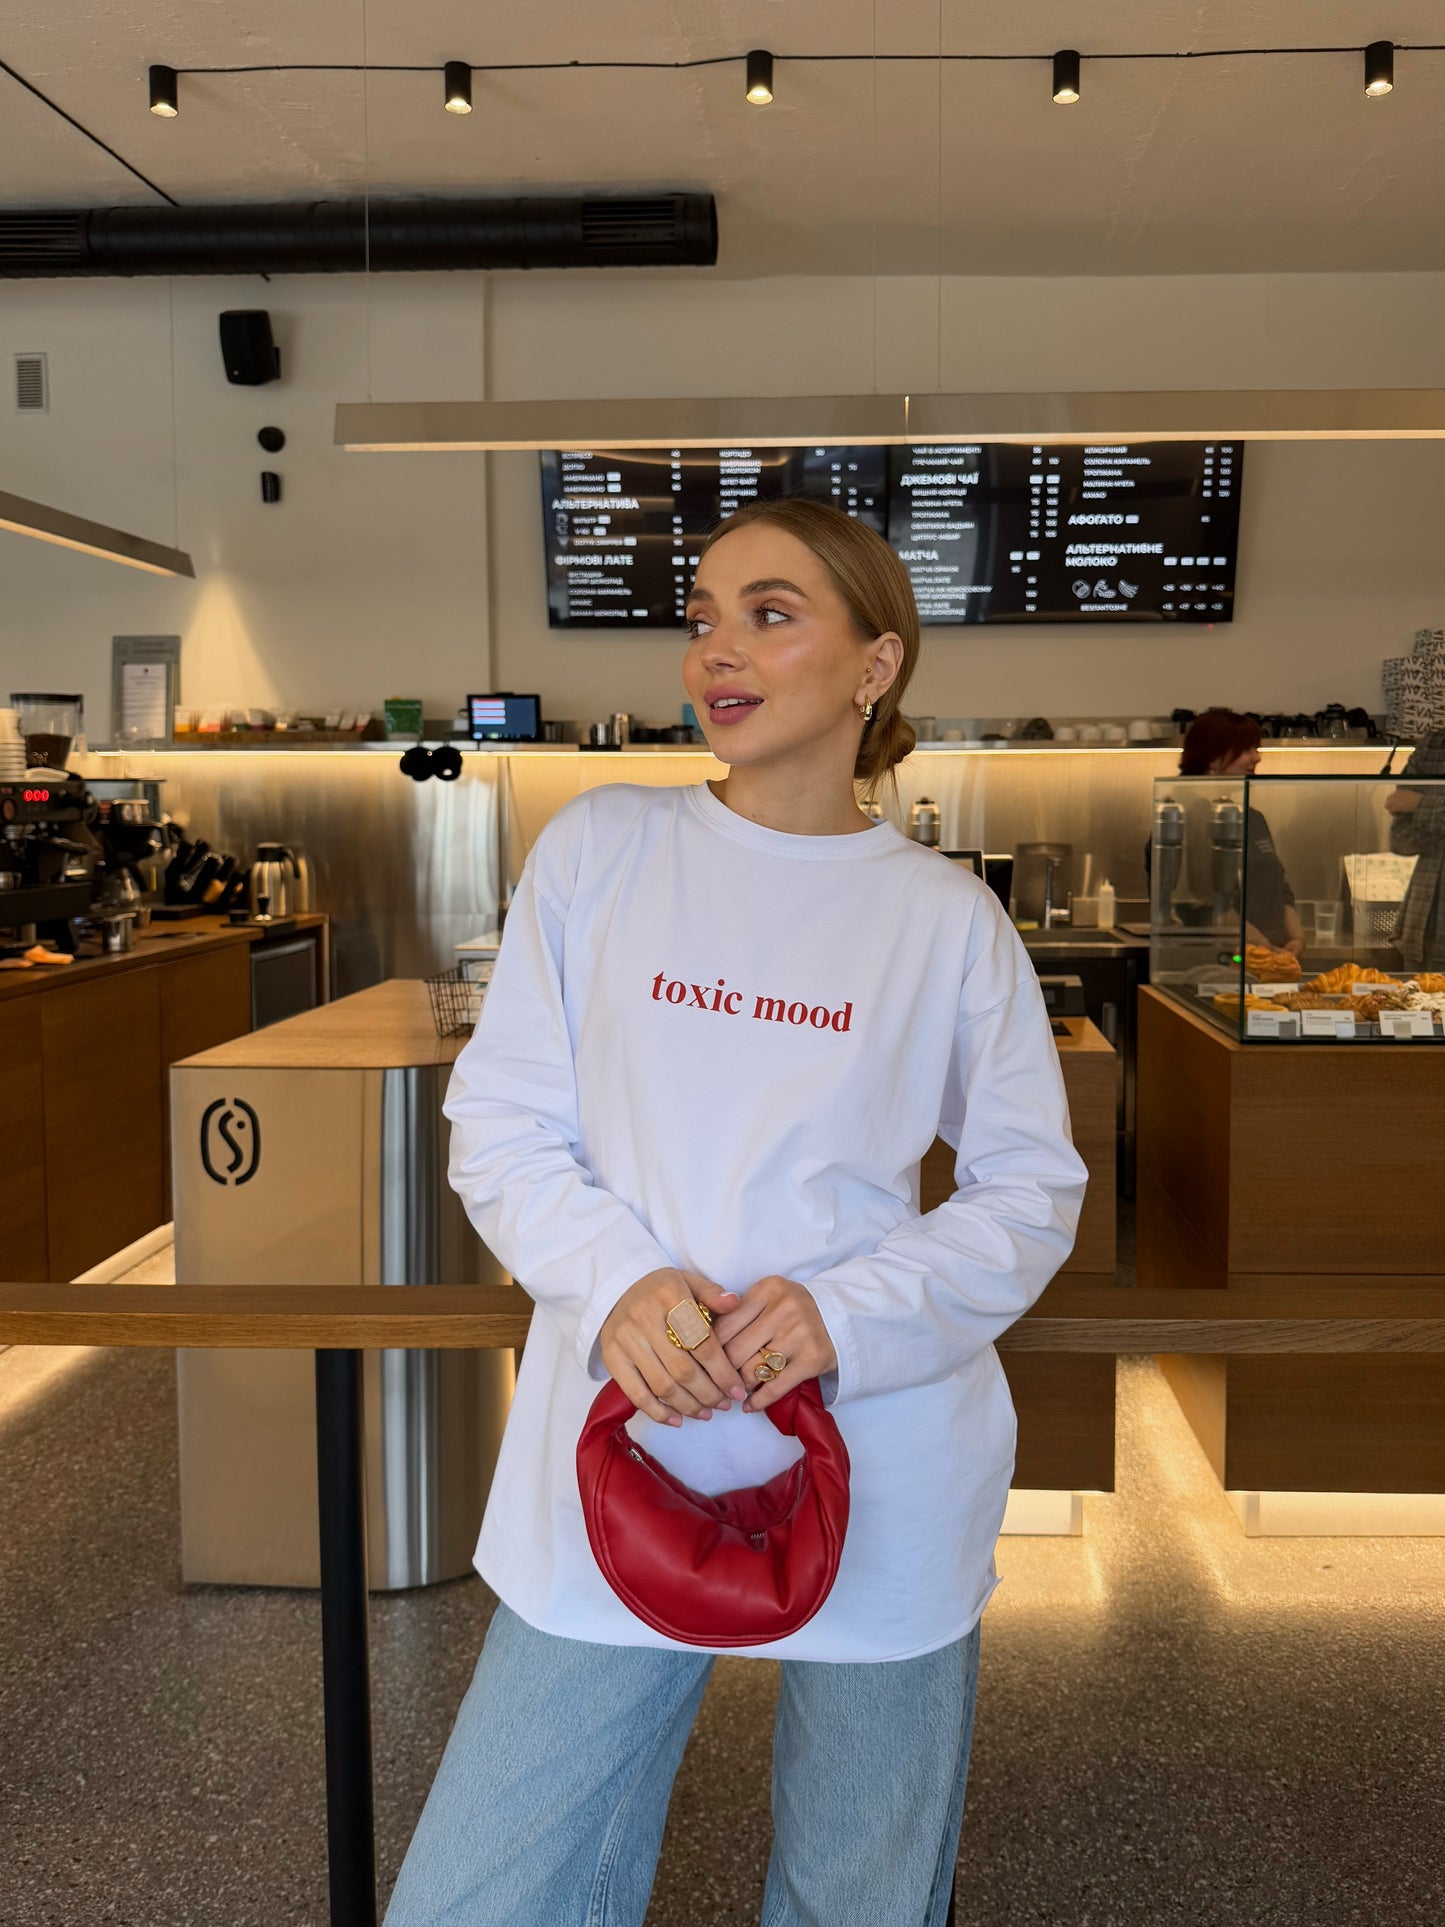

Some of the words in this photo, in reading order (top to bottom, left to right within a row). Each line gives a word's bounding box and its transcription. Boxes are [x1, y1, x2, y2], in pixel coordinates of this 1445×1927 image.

[900, 473, 956, 486] ДЖЕМОВІ
[552, 498, 639, 509] АЛЬТЕРНАТИВА
[1068, 514, 1124, 525] АФОГАТО
[1066, 543, 1163, 554] АЛЬТЕРНАТИВНЕ
[555, 555, 602, 565] ФІРМОВІ
[604, 555, 633, 565] ЛАТЕ
[1066, 556, 1118, 567] МОЛОКО
[651, 971, 743, 1015] toxic
[752, 996, 853, 1033] mood
